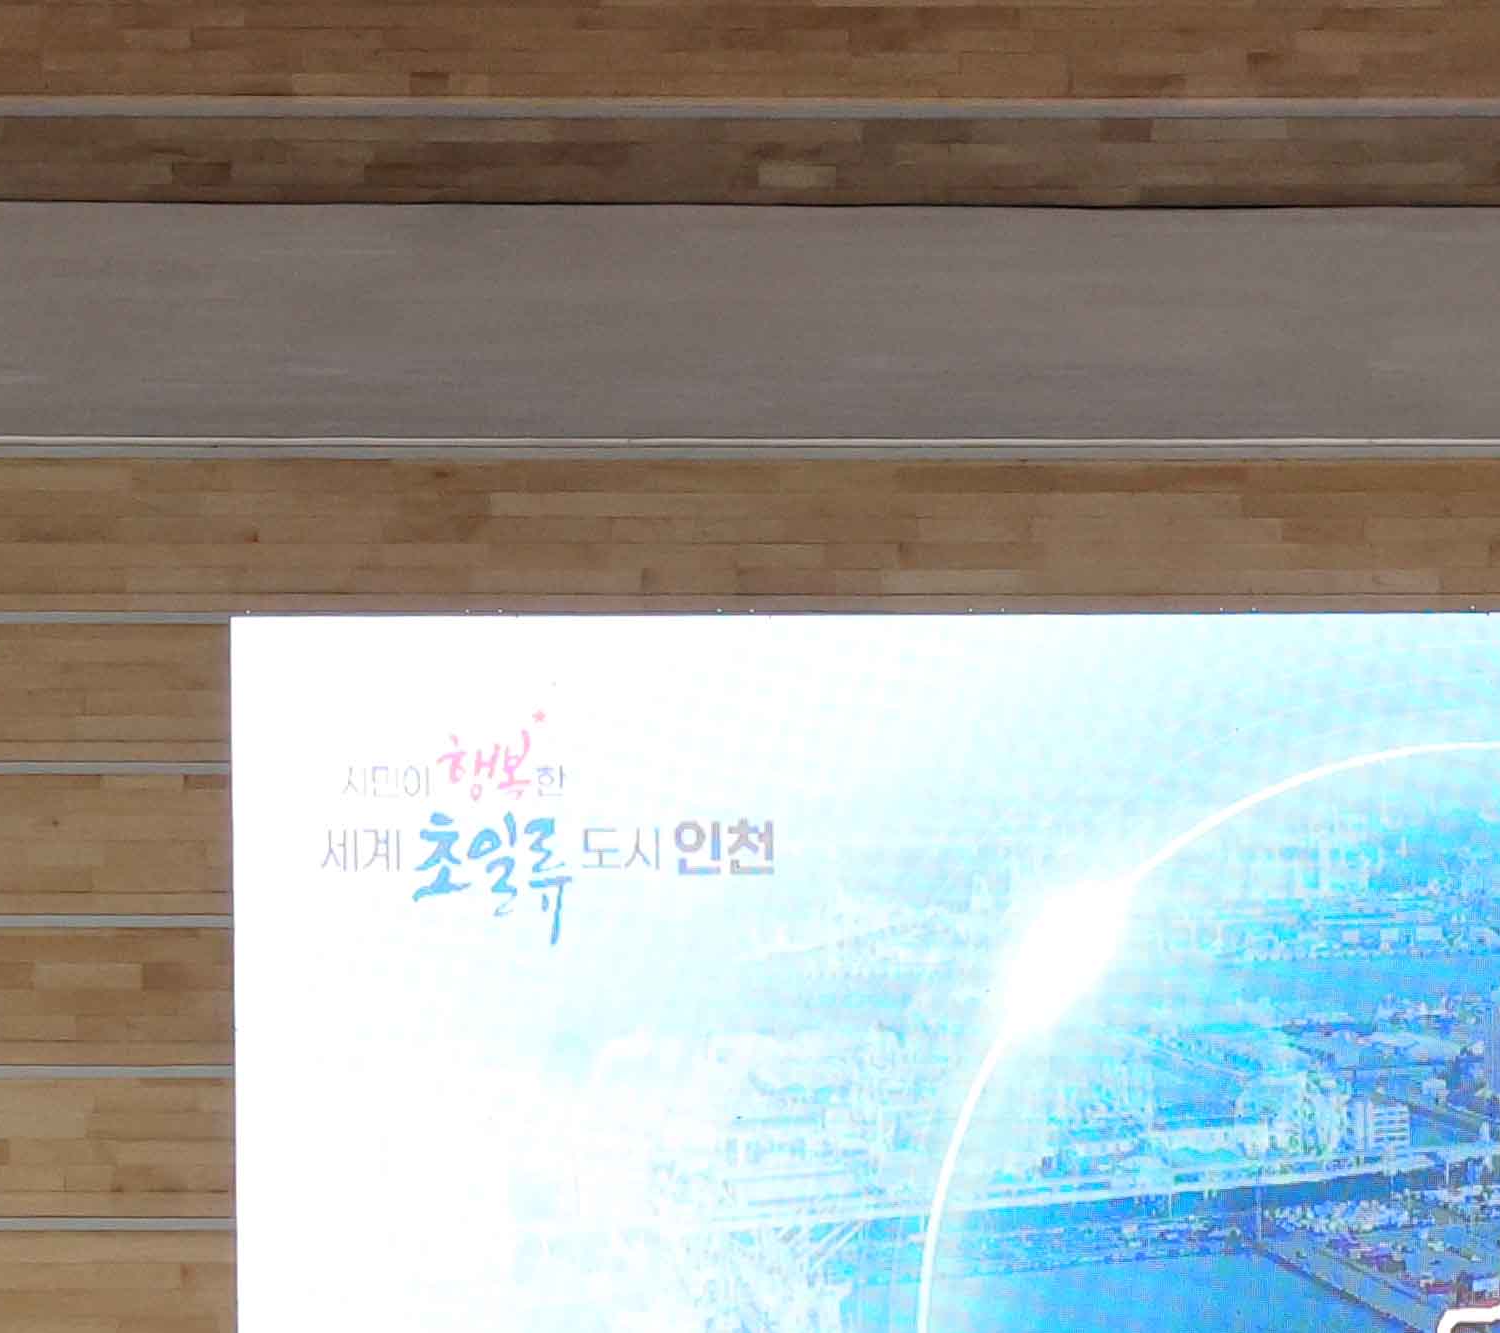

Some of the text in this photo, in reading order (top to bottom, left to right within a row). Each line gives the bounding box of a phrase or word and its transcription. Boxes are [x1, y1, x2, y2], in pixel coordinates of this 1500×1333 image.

[342, 729, 567, 801] 시민이 행복한
[320, 811, 775, 945] 세계 초일류 도시 인천
